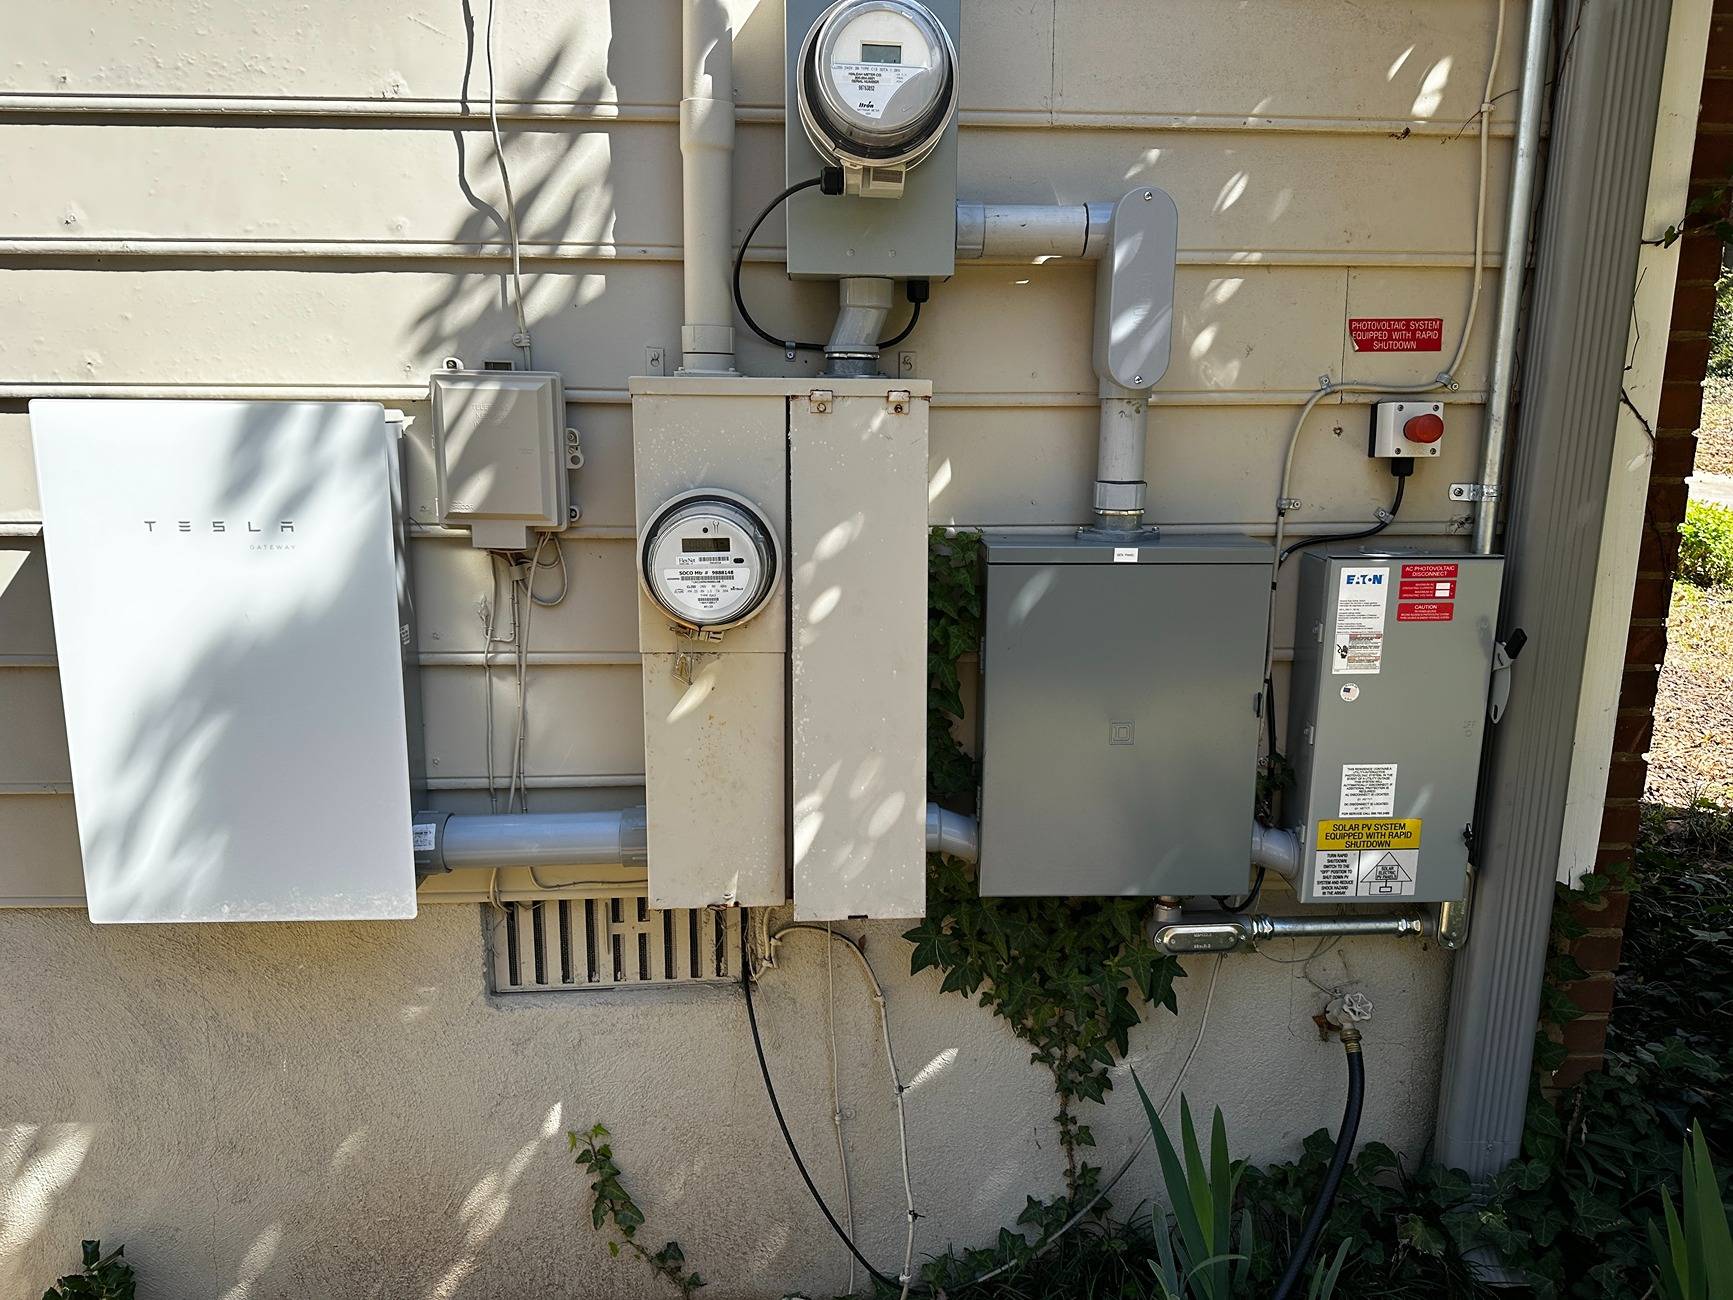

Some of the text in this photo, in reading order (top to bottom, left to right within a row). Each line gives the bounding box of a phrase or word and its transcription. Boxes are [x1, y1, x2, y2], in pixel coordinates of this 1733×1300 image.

[1351, 320, 1440, 330] PHOTOVOLTAIC SYSTEM
[1352, 330, 1439, 340] EQUIPPED WITH RAPID
[1373, 341, 1417, 350] SHUTDOWN
[144, 521, 294, 532] TESLA
[1346, 574, 1383, 585] EATON
[1361, 823, 1373, 831] PV
[1325, 832, 1363, 840] EQUIPPED
[1388, 831, 1413, 839] RAPID
[1345, 840, 1391, 848] SHUTDOWN
